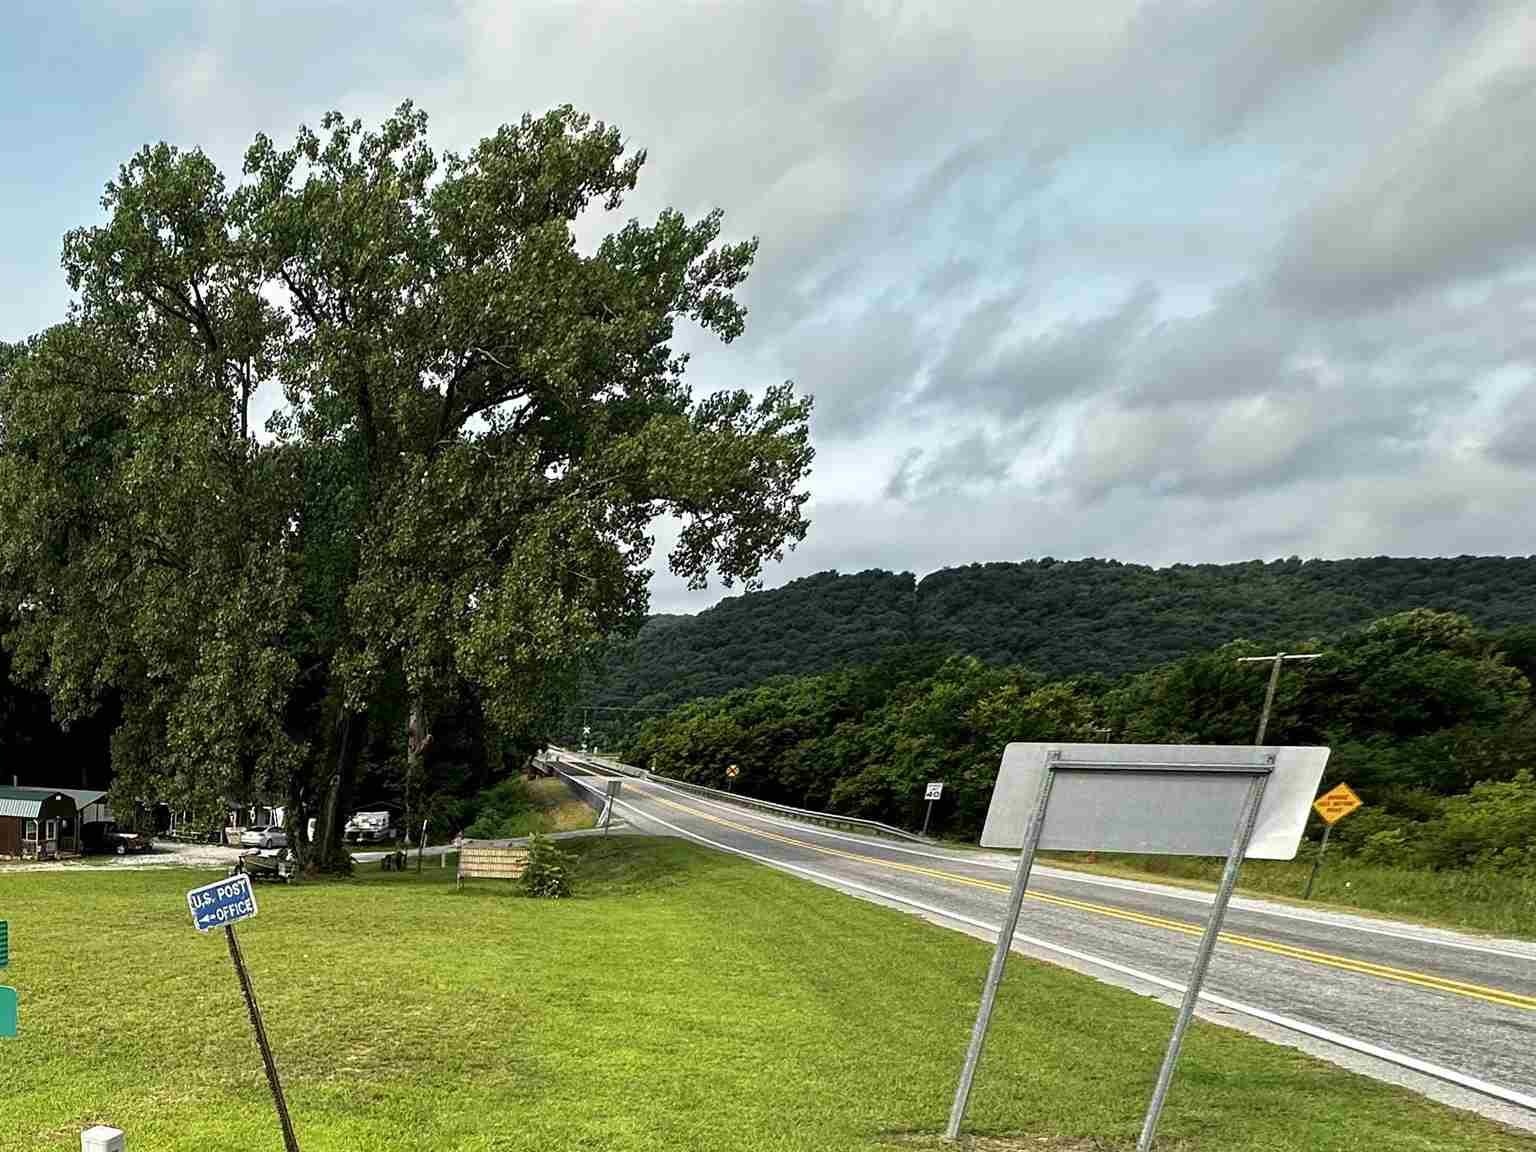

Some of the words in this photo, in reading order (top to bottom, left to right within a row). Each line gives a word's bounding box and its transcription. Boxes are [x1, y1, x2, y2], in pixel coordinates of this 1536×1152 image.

[192, 892, 215, 908] U.S.
[217, 880, 245, 901] POST
[216, 898, 252, 920] OFFICE
